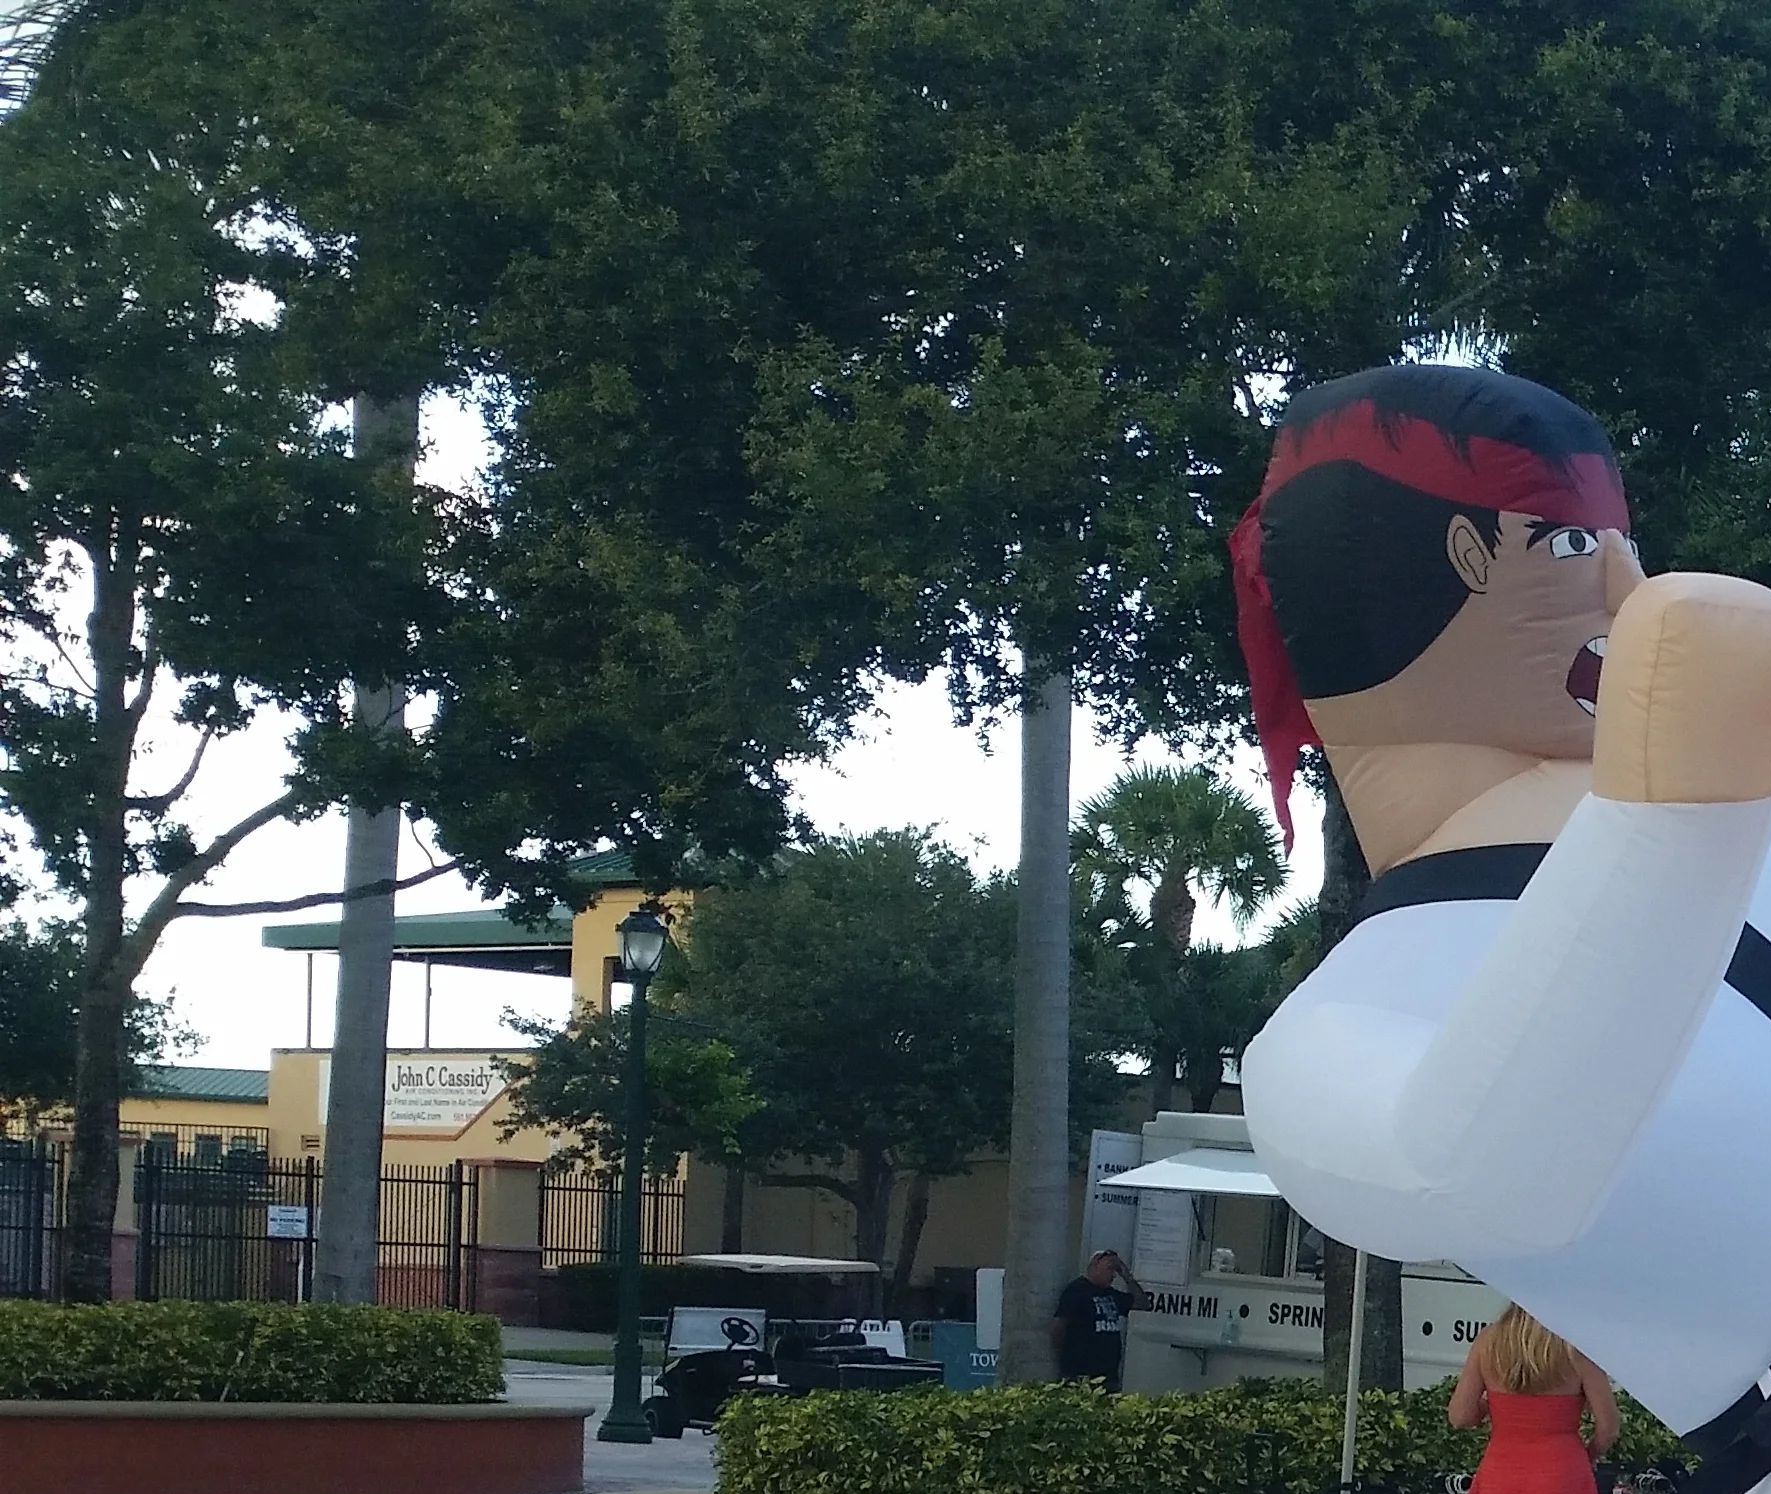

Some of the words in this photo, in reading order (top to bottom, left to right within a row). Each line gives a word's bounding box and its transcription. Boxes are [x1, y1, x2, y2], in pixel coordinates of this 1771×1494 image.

[391, 1065, 423, 1092] John
[426, 1066, 435, 1087] C
[439, 1065, 493, 1094] Cassidy
[1197, 1296, 1218, 1319] MI
